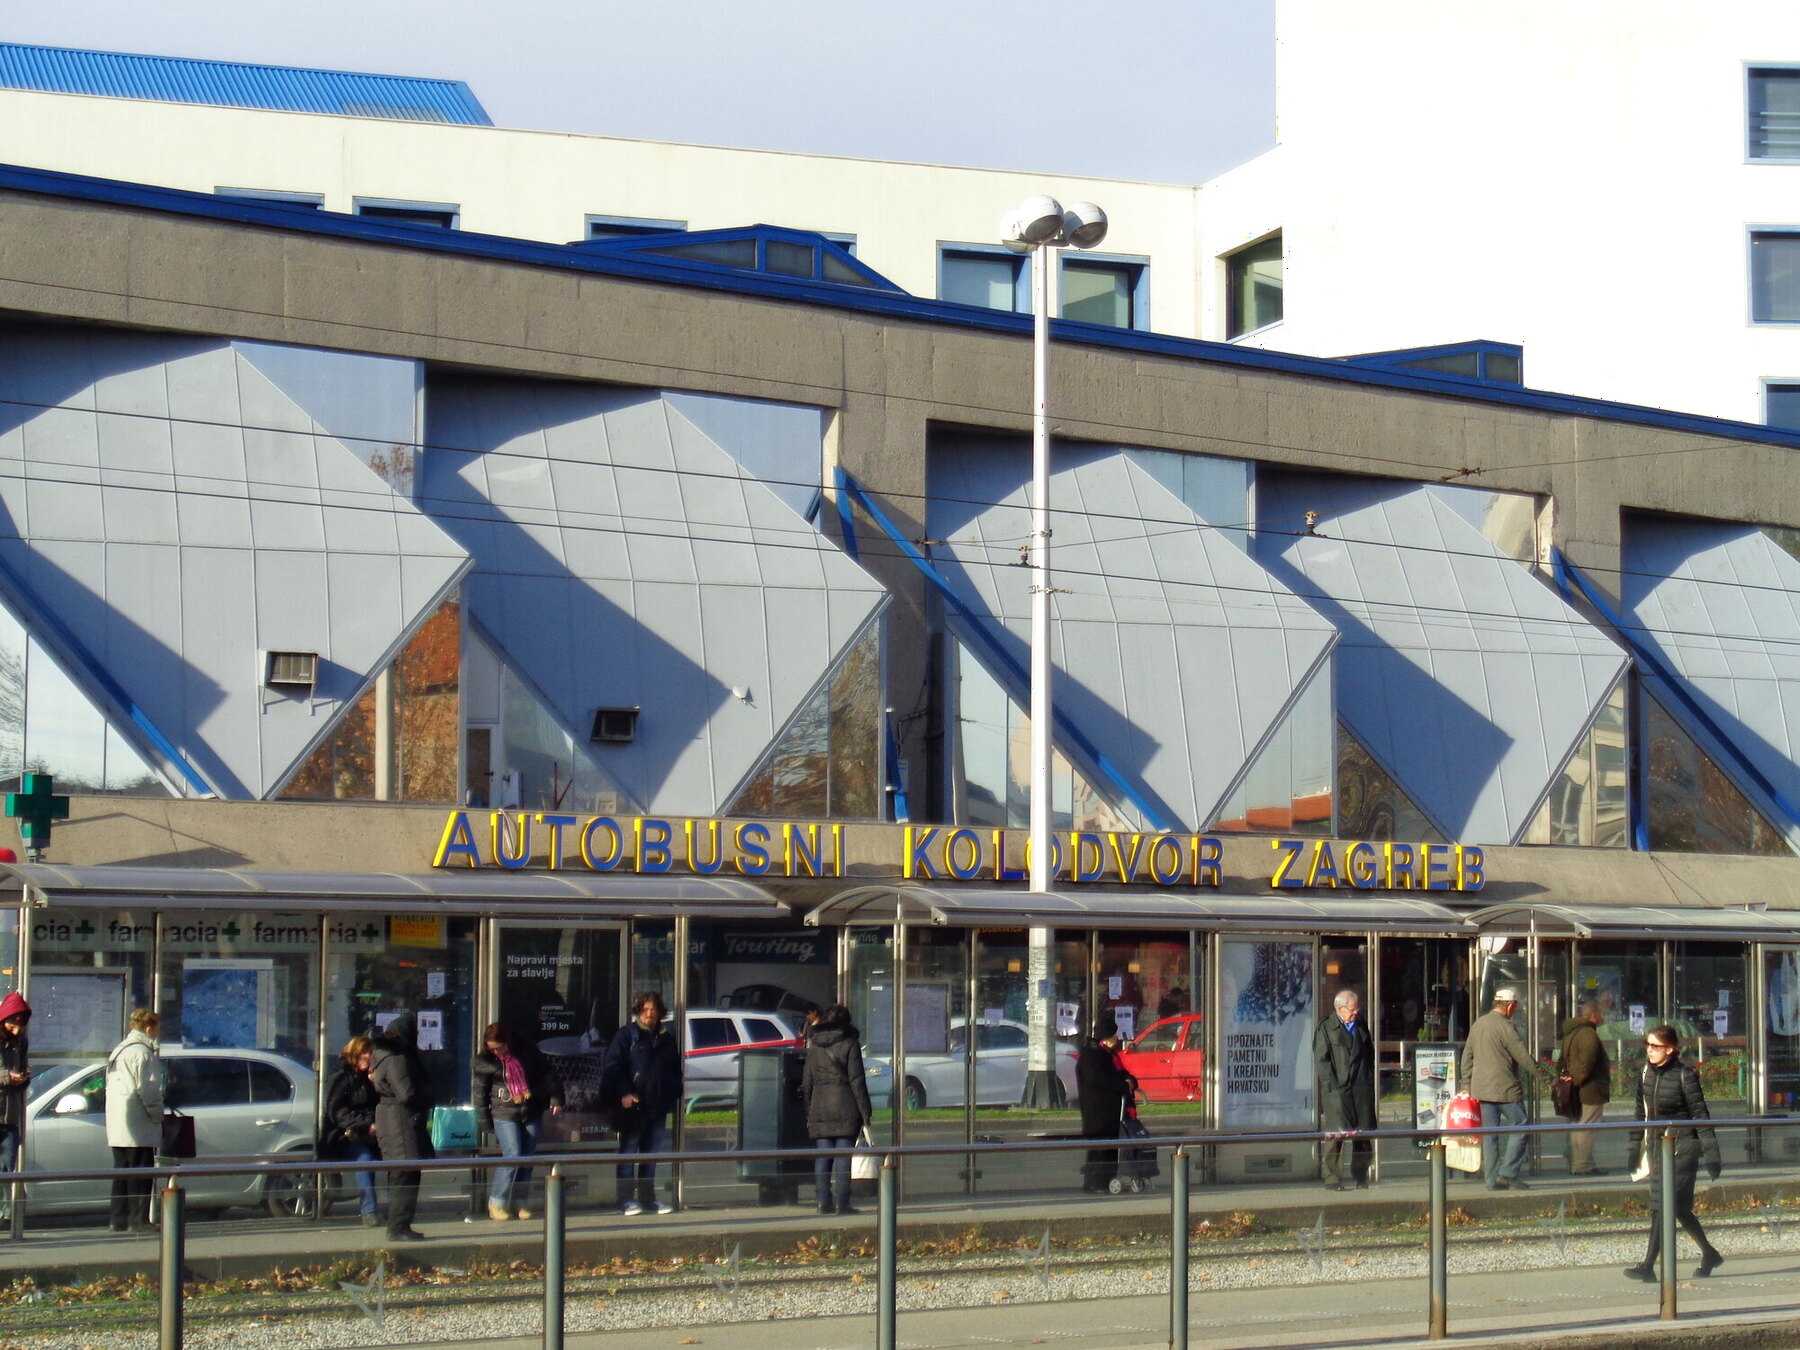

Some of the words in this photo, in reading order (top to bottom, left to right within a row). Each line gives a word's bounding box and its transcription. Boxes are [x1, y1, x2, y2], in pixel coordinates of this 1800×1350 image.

[432, 809, 847, 878] AUTOBUSNI
[1270, 838, 1487, 891] ZAGREB
[108, 920, 218, 943] faracia
[507, 954, 546, 967] Napravi
[506, 969, 519, 978] za
[1227, 1034, 1274, 1048] UPOZNAJTE
[1227, 1049, 1267, 1063] PAMETNU
[1227, 1065, 1231, 1078] I
[1233, 1064, 1280, 1079] KREATIVNU
[1227, 1080, 1270, 1094] HRVATSKU
